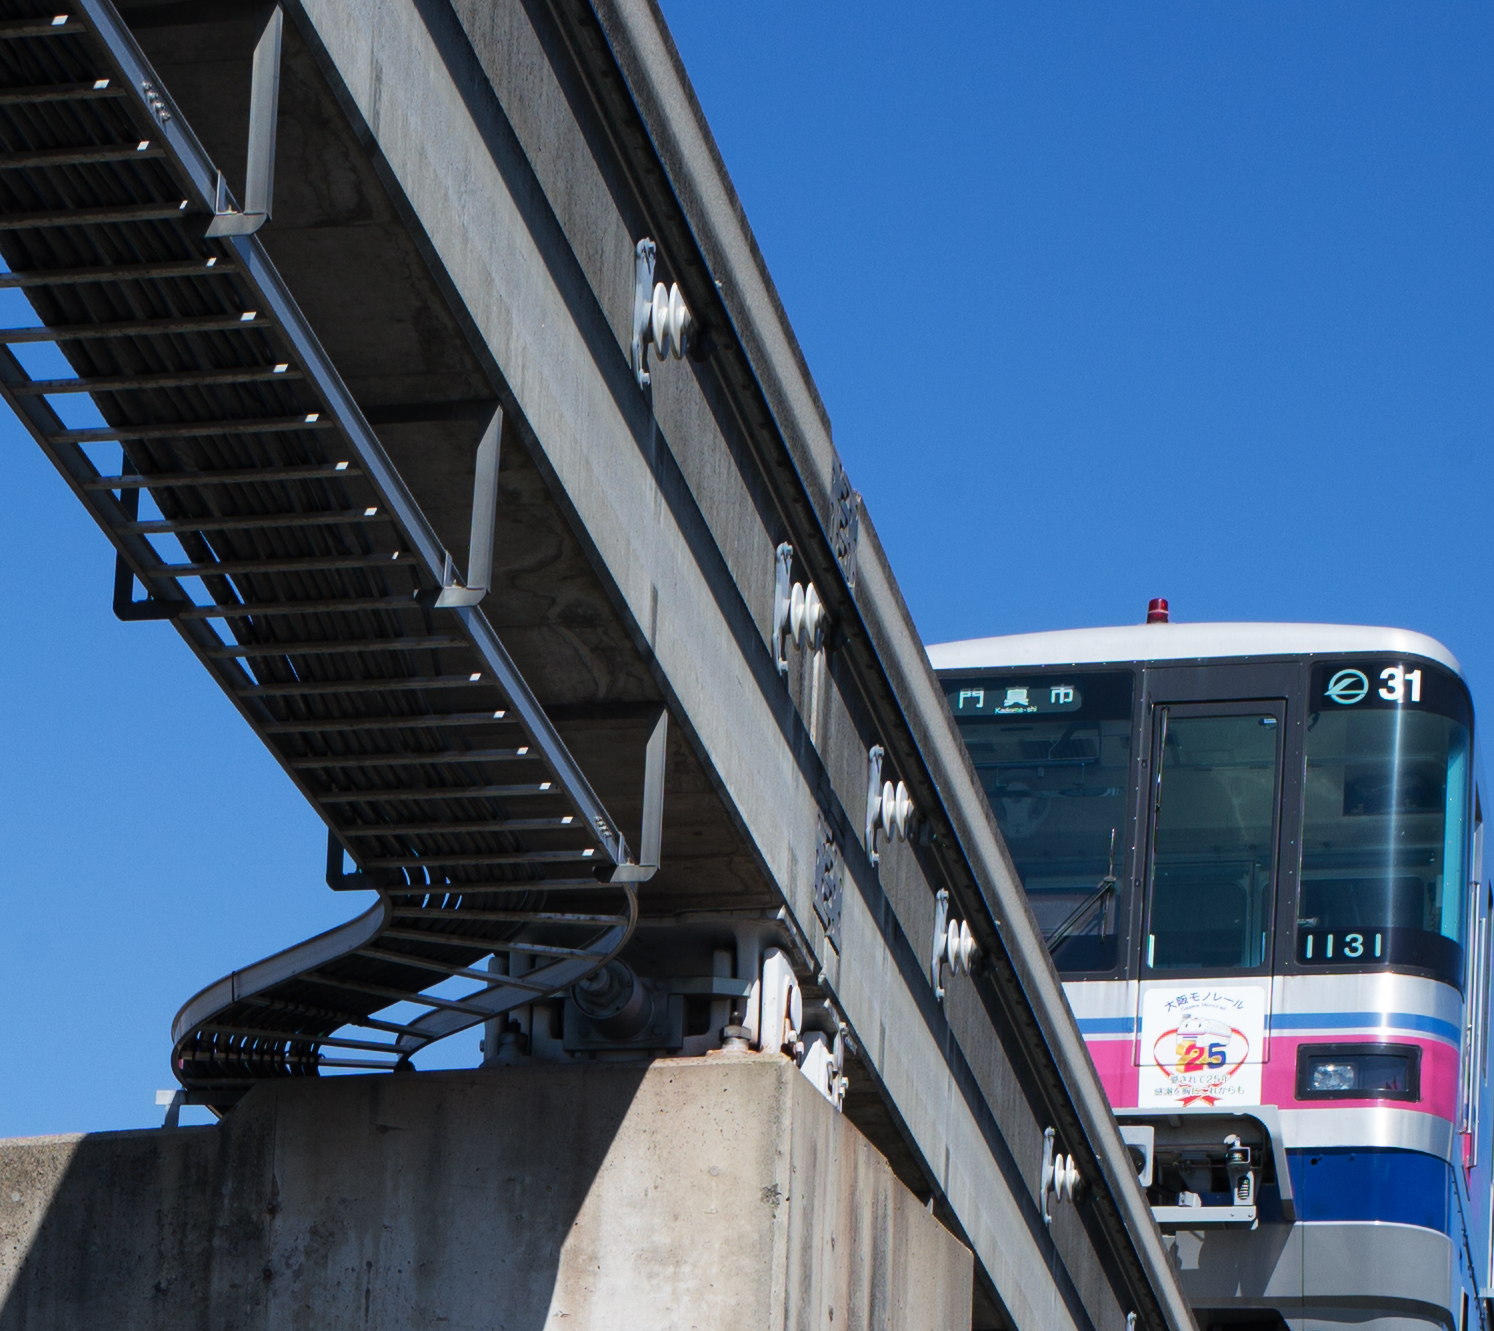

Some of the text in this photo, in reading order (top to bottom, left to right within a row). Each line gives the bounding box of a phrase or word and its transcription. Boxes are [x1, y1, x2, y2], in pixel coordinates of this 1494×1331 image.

[959, 684, 1075, 709] 門真市
[1379, 667, 1422, 703] 31
[1306, 933, 1383, 959] 1131
[1164, 992, 1244, 1012] 大阪モノレール
[1180, 1042, 1227, 1074] 25
